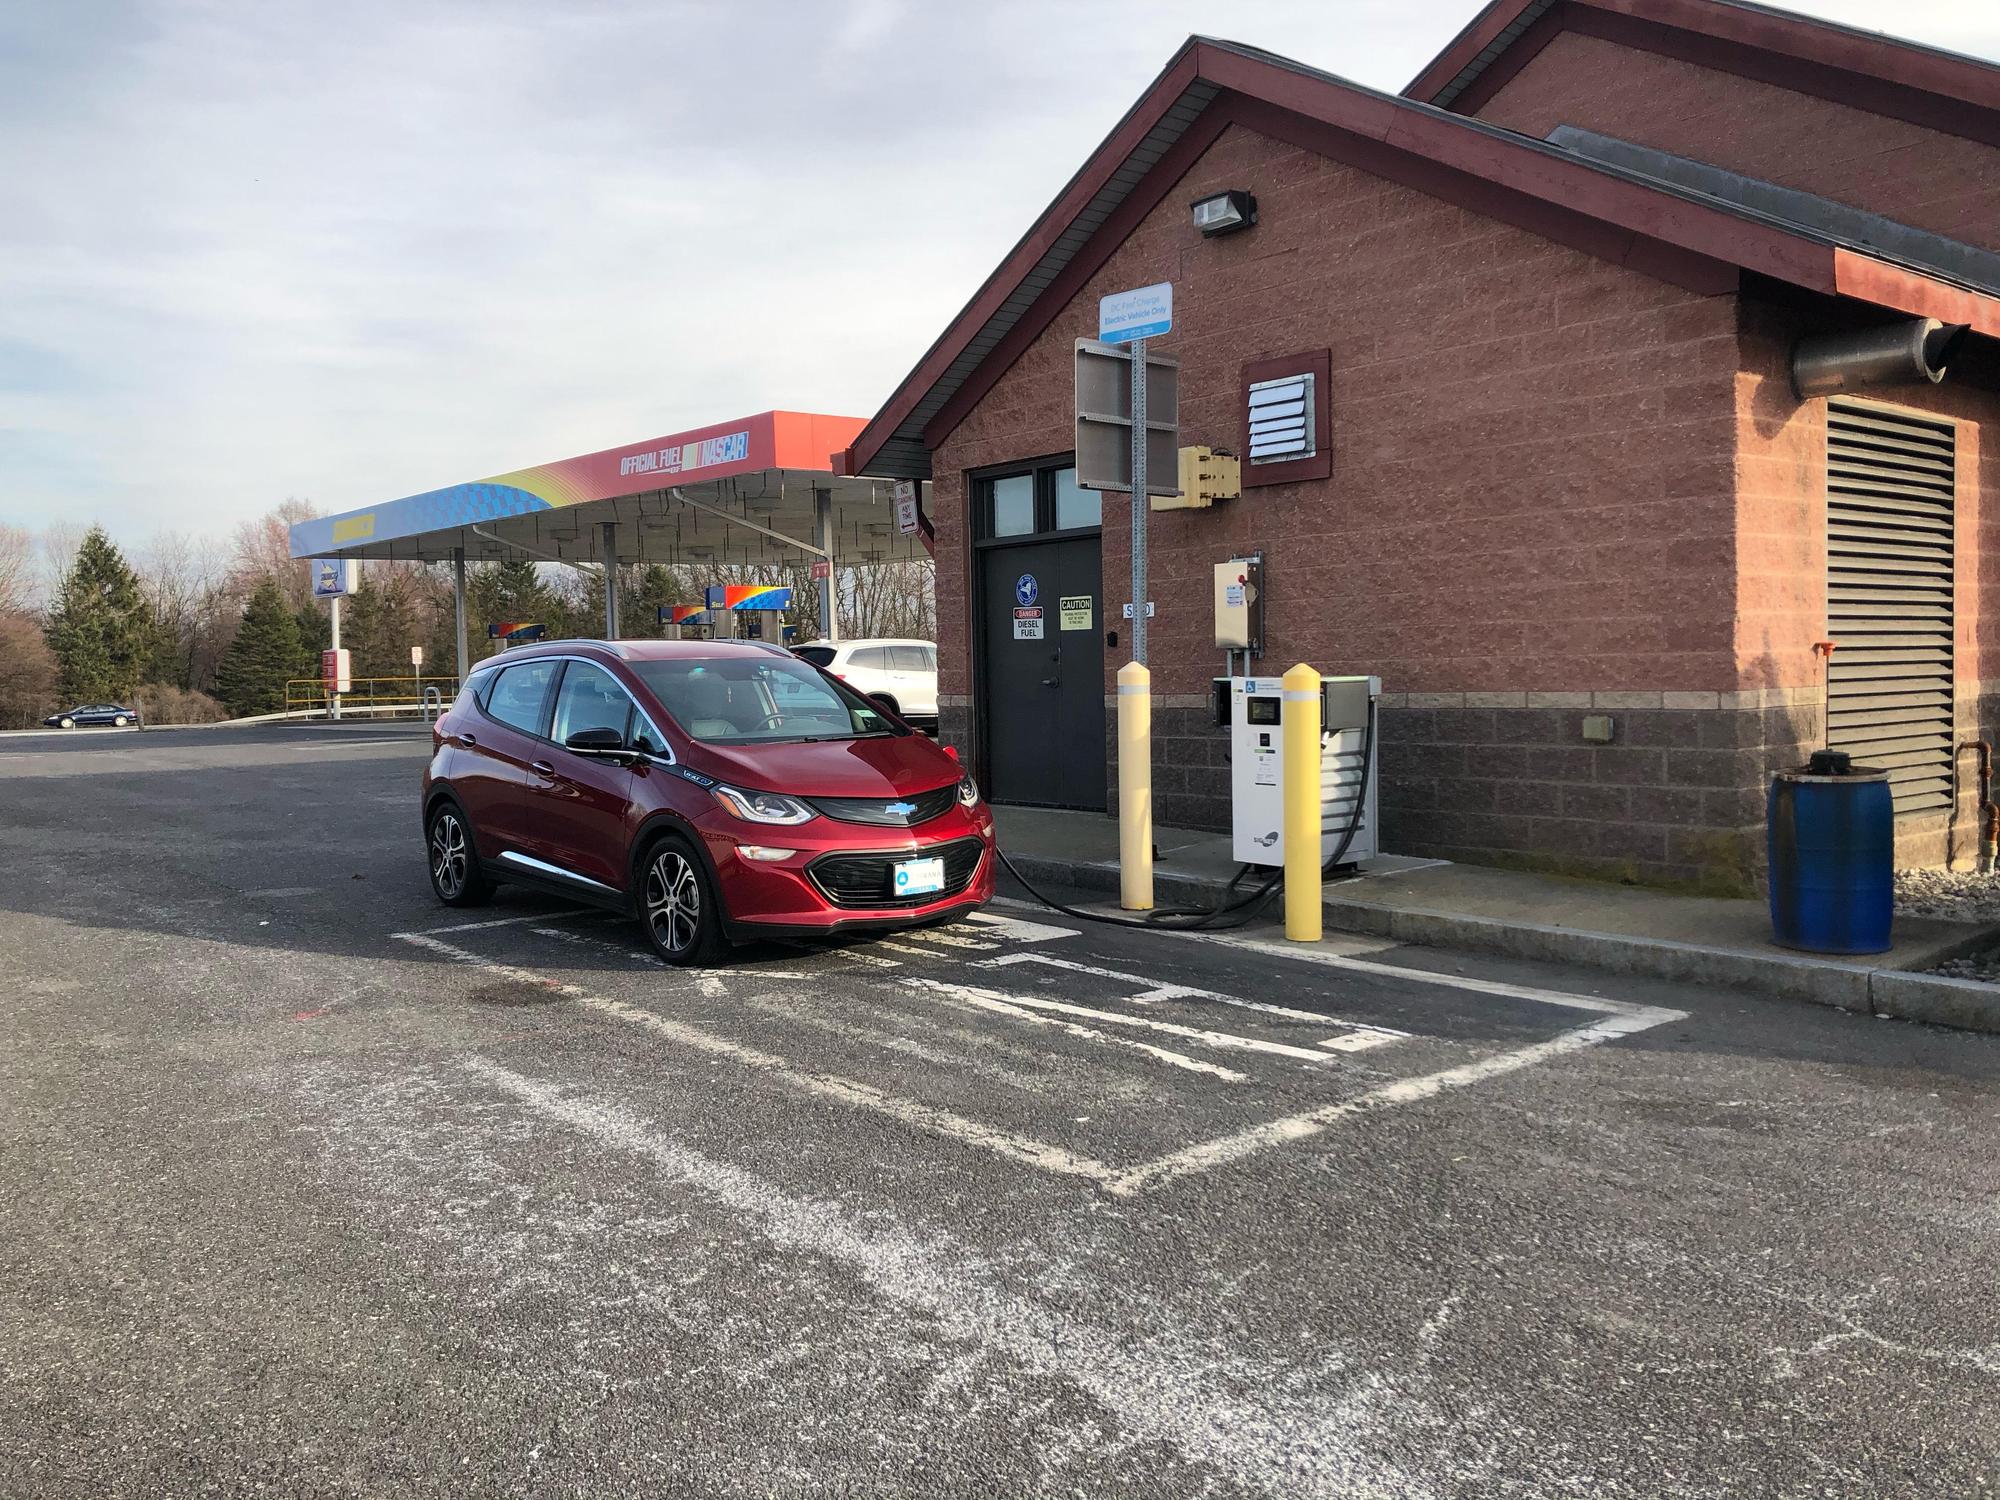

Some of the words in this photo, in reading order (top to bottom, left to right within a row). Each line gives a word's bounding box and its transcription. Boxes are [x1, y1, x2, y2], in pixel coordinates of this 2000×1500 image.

[702, 432, 749, 466] NASCAR
[621, 451, 658, 475] OFFICIAL
[659, 446, 681, 467] FUEL
[1061, 600, 1090, 609] CAUTION
[1018, 620, 1039, 628] DIESEL
[1021, 629, 1037, 637] FUEL
